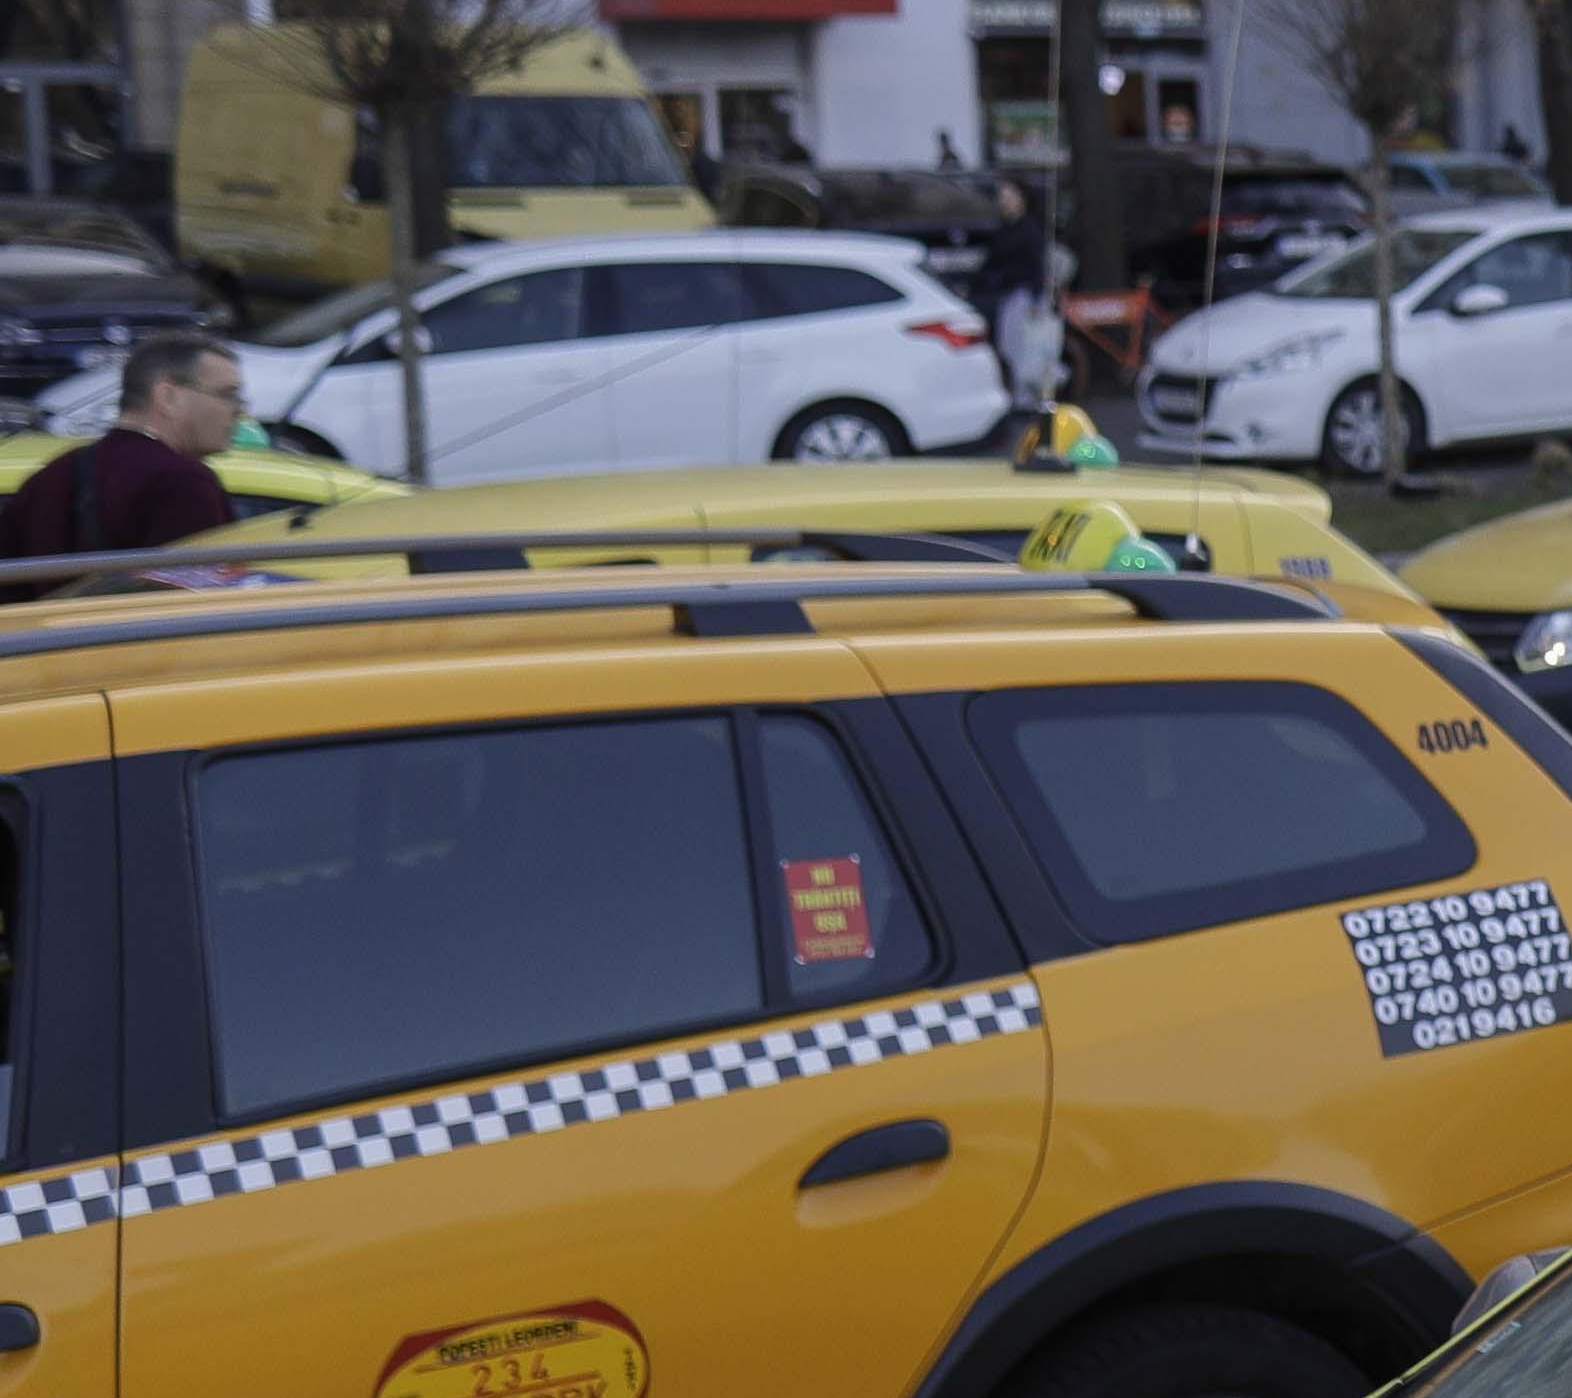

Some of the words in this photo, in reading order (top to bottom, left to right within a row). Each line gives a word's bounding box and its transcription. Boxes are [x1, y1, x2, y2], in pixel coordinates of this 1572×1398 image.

[1418, 719, 1489, 754] 4004
[1344, 902, 1434, 938] 0722
[1468, 880, 1549, 916] 9477
[1355, 929, 1442, 966] 0723
[1441, 922, 1481, 950] 10
[1480, 906, 1560, 943] 9477
[1366, 955, 1453, 995] 0724
[1453, 949, 1491, 978] 10
[1492, 933, 1570, 971] 9477
[1374, 984, 1459, 1025] 0740
[1460, 977, 1497, 1007] 10
[472, 1353, 549, 1397] 234
